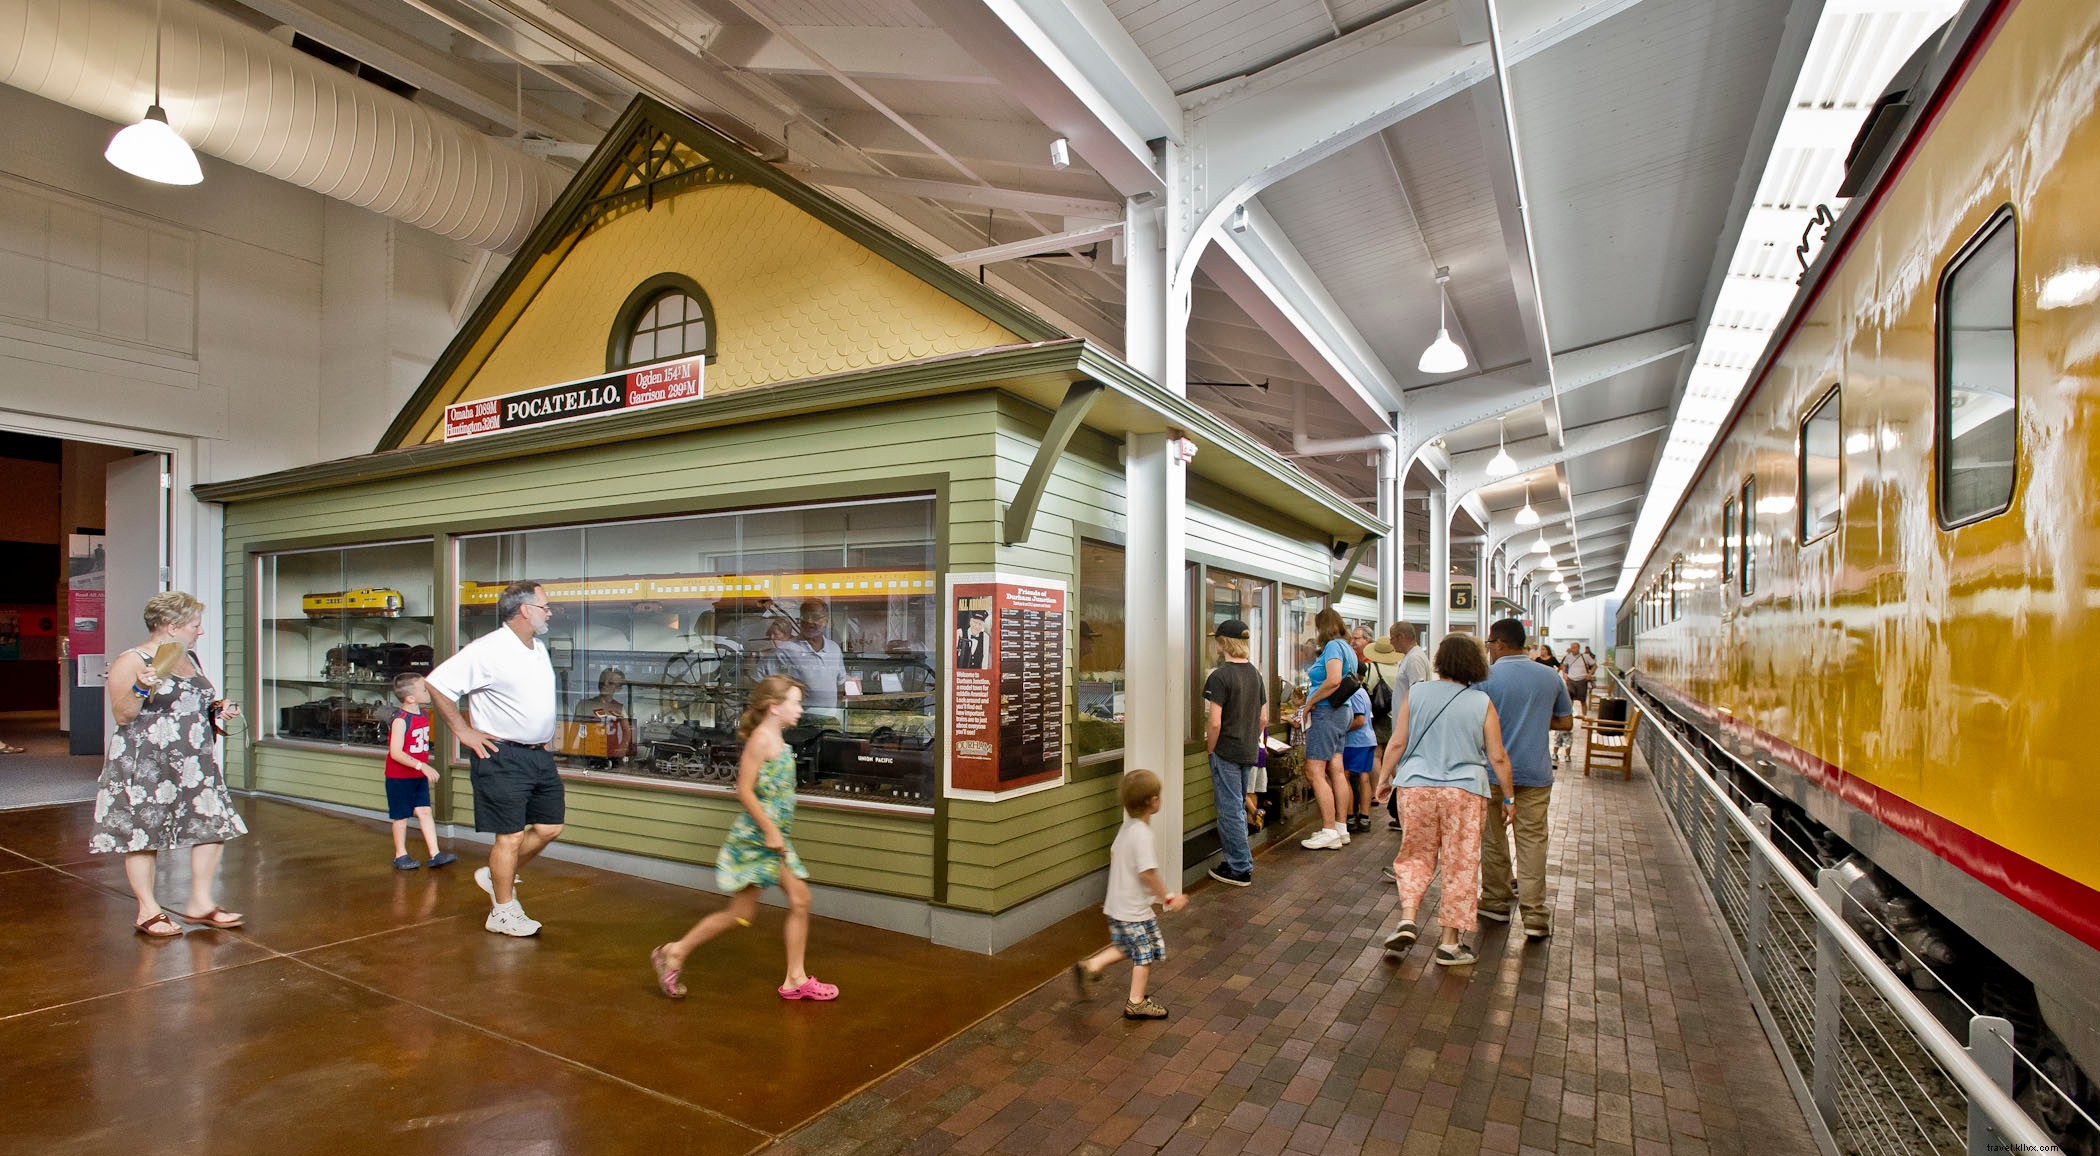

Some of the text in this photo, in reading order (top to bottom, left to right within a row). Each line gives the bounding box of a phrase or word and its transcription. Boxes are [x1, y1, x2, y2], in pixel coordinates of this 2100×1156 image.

[635, 371, 662, 389] Ogden
[507, 385, 621, 421] POCATELLO.
[629, 388, 666, 405] Garrison
[451, 400, 498, 421] Omaha 1089M
[447, 420, 482, 435] Huntington
[1005, 593, 1057, 604] Durham Junction
[1017, 588, 1041, 596] Friends
[1456, 592, 1467, 606] 5
[956, 740, 992, 753] DURHAM
